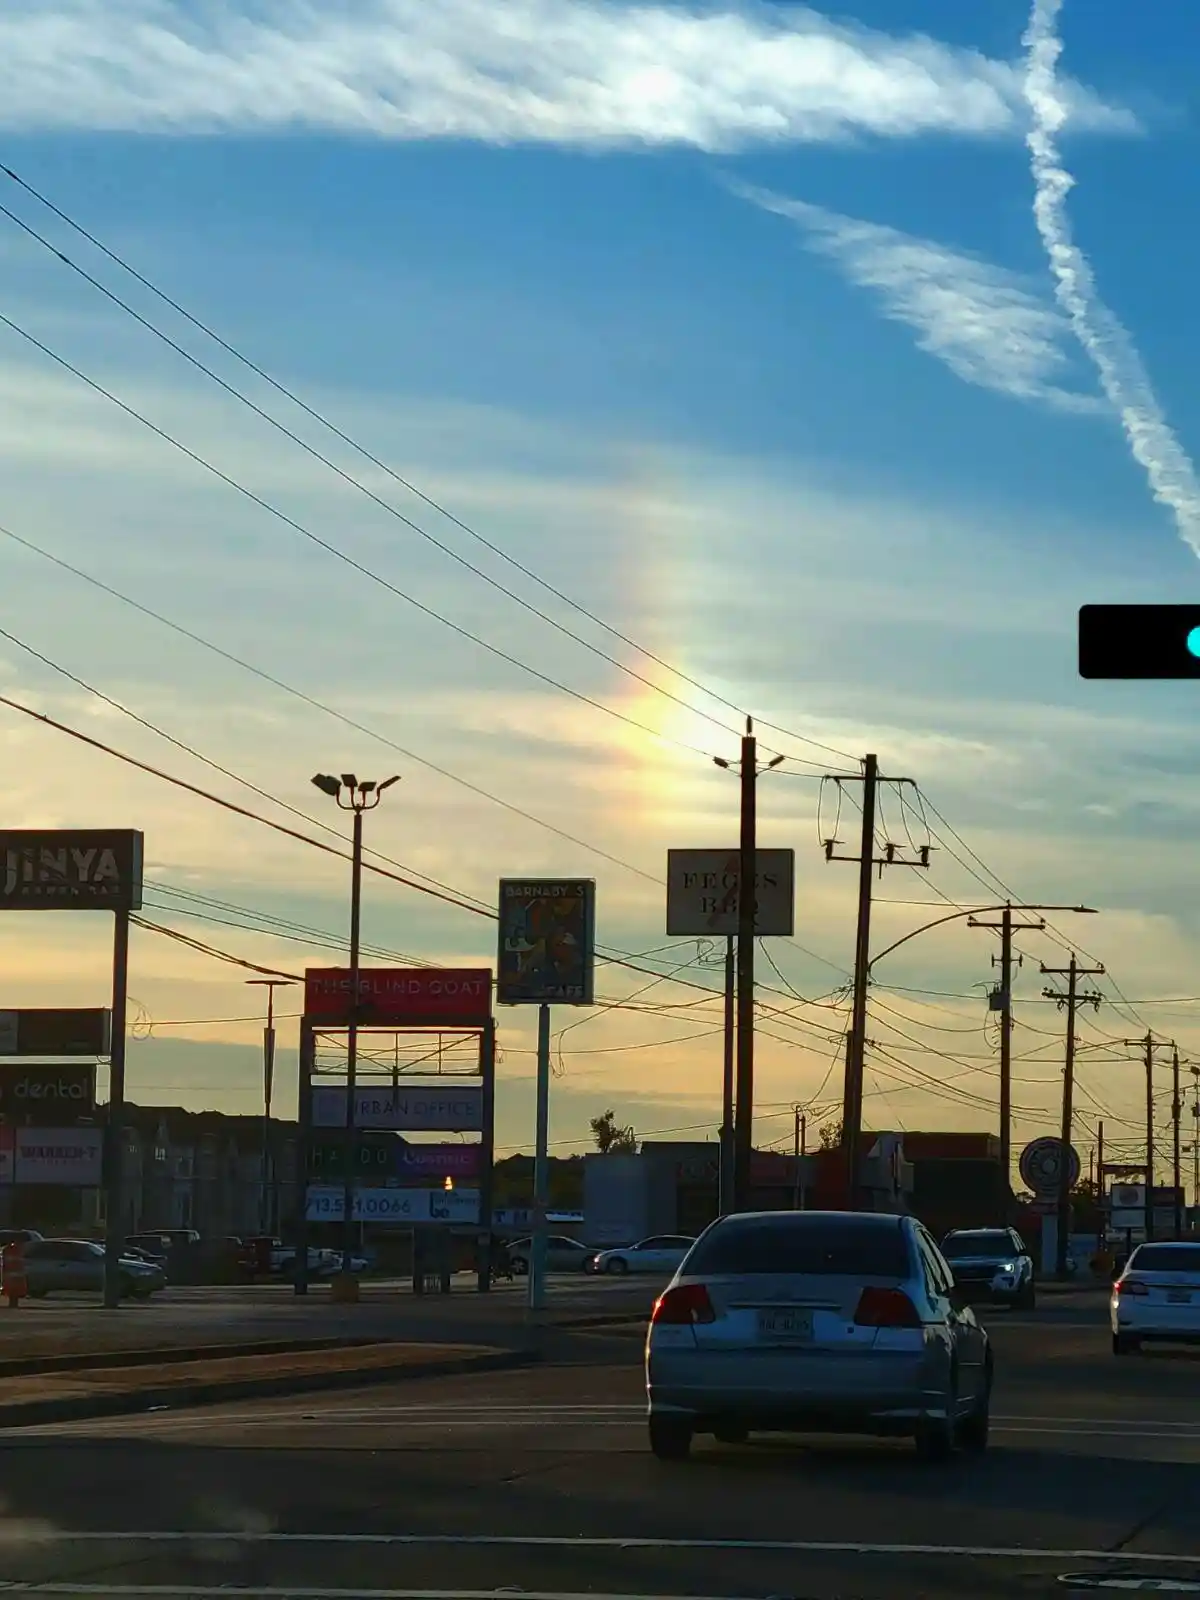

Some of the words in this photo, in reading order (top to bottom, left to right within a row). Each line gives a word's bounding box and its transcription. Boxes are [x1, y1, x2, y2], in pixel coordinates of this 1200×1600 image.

[683, 869, 779, 889] FEGS
[359, 979, 421, 994] BLIND
[428, 979, 483, 995] GOAT
[14, 1077, 88, 1099] dental
[413, 1100, 475, 1116] OFFICE
[304, 1197, 411, 1214] 713.51.0066
